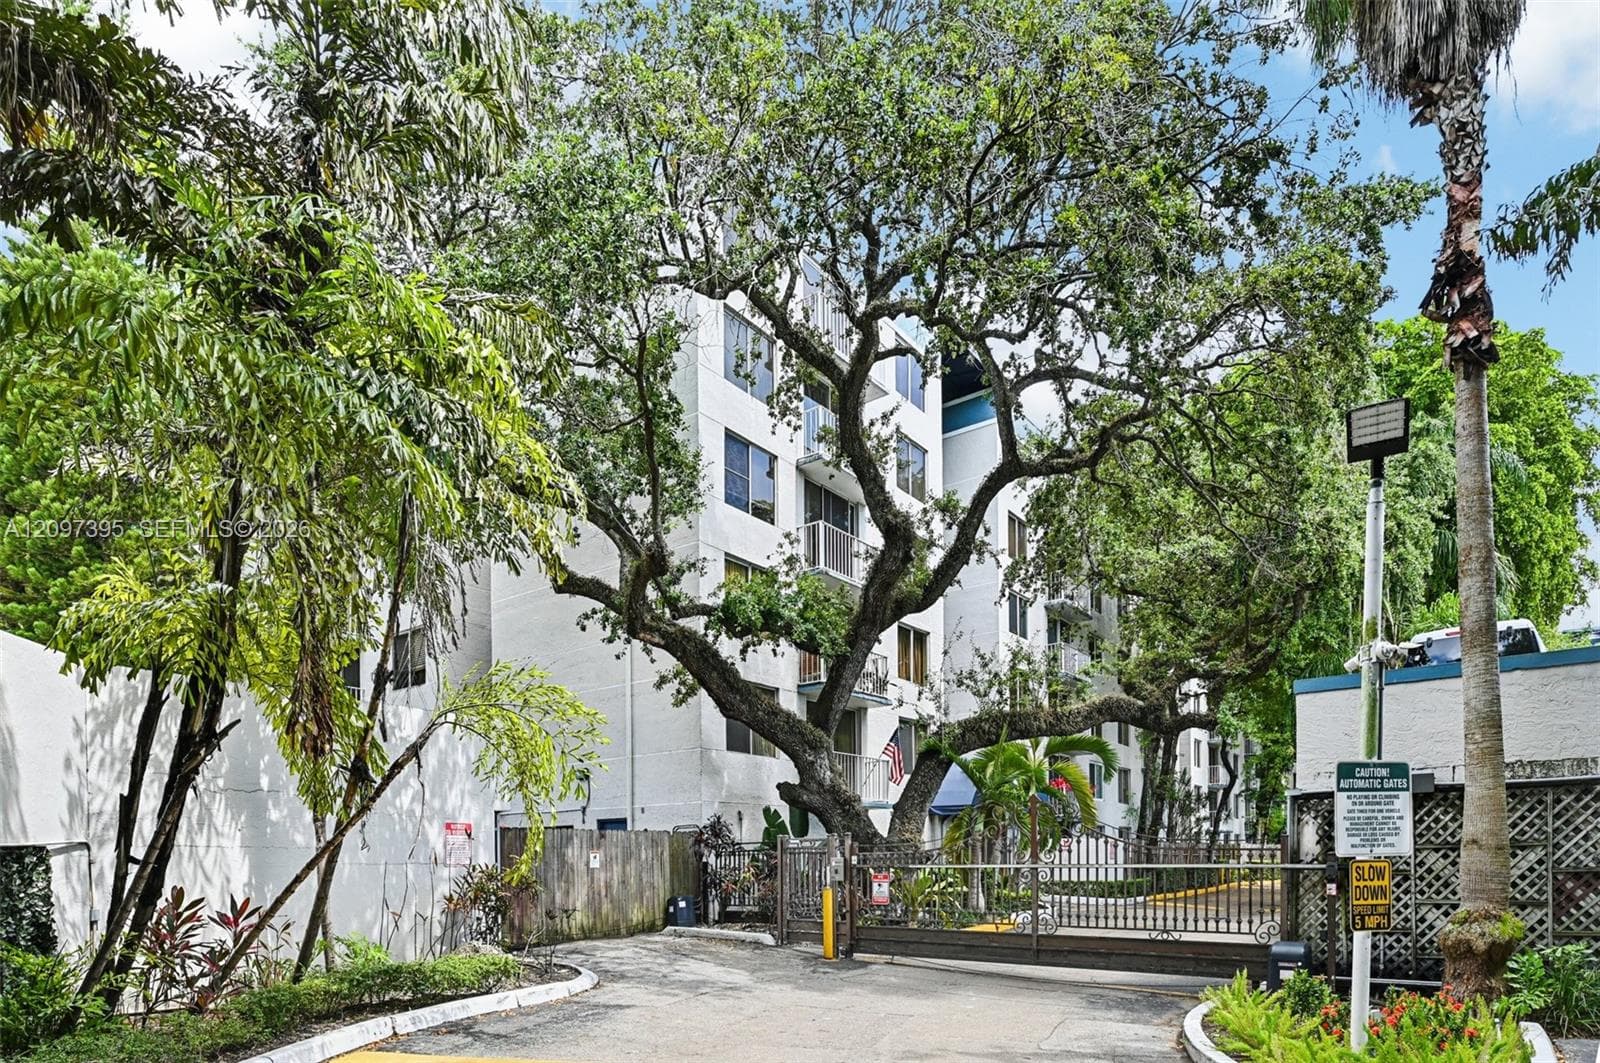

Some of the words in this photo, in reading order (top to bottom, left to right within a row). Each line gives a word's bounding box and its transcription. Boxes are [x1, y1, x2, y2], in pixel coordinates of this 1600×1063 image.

[1355, 767, 1390, 777] CAUTION!
[1339, 778, 1381, 789] AUTOMATIC
[1383, 778, 1408, 789] GATES
[1355, 865, 1386, 882] SLOW
[1354, 885, 1388, 902] DOWN
[1353, 906, 1372, 914] SPEED
[1372, 906, 1389, 914] LIMIT
[1354, 916, 1362, 928] 5
[1364, 916, 1388, 928] MPH
